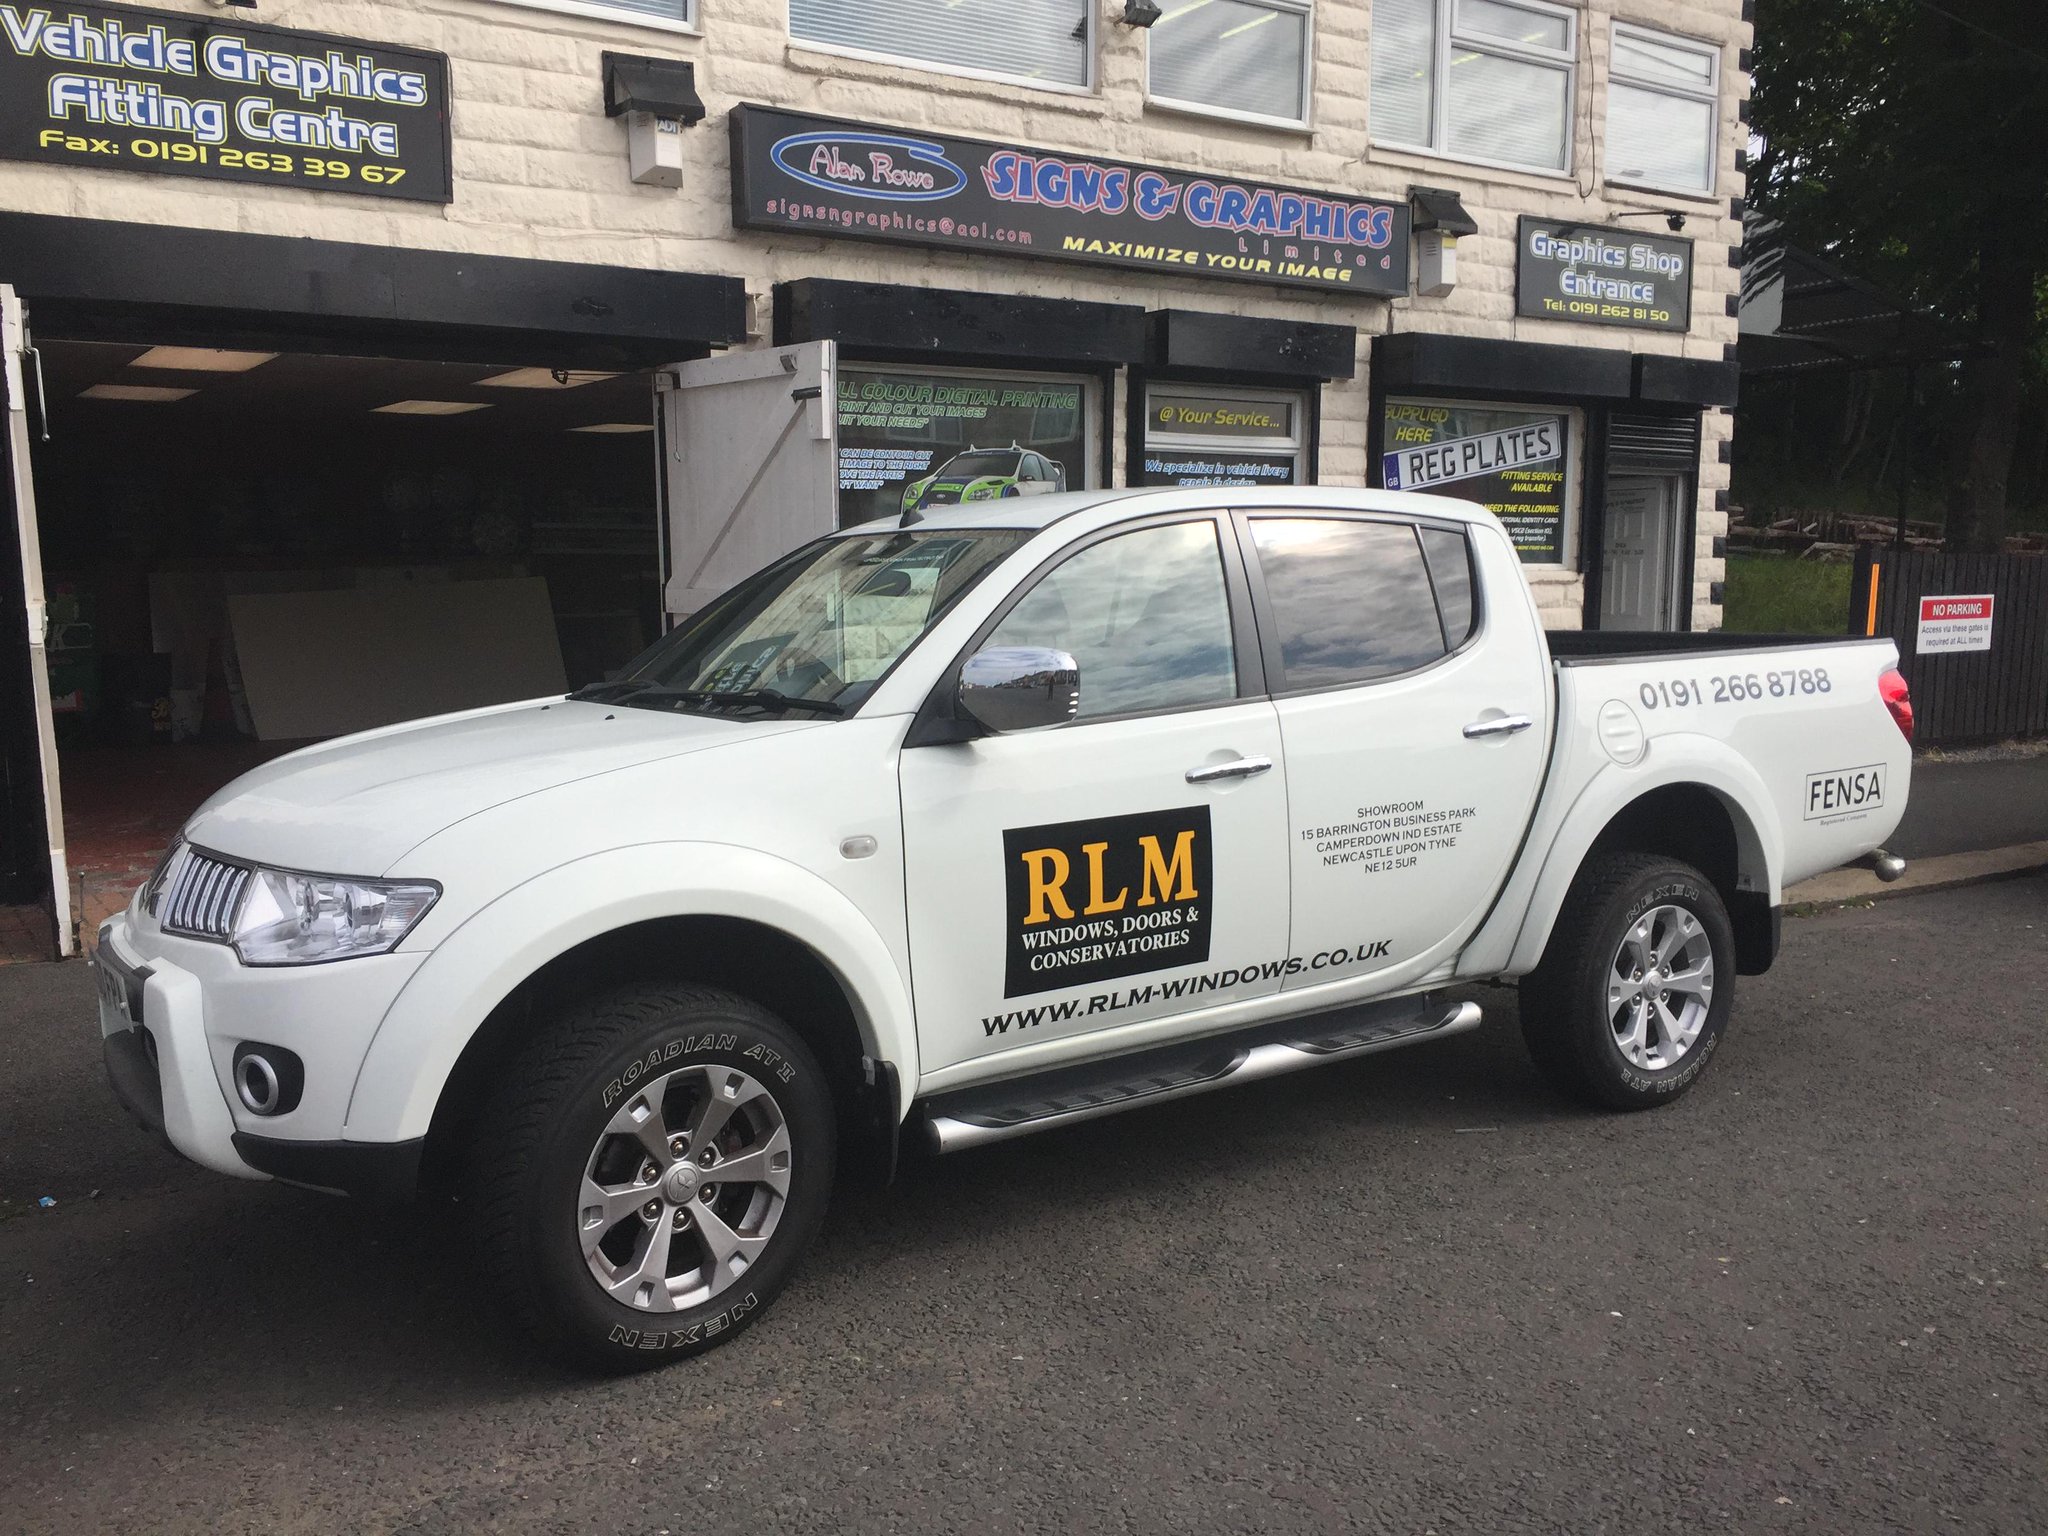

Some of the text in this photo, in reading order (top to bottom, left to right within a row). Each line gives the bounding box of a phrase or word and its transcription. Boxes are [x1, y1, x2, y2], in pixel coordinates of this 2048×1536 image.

[0, 5, 428, 106] Vehicle Graphics
[48, 74, 399, 157] Fitting Centre
[40, 130, 405, 185] Fax: 0191 263 39 67
[809, 144, 934, 189] Alan Rowe
[980, 150, 1394, 248] SIGNS & GRAPHICS
[766, 199, 1032, 244] signsngraphics@aol.com
[1063, 236, 1352, 281] MAXIMIZE YOUR IMAGE
[1530, 230, 1684, 280] Graphics Shop
[1559, 267, 1654, 304] Entrance
[1544, 298, 1669, 322] Tel: 0191 262 81 50
[861, 382, 932, 403] COLOUR
[936, 387, 998, 406] DIGITAL
[1001, 390, 1078, 409] PRINTING
[867, 402, 892, 415] AND
[893, 404, 917, 416] CUT
[917, 405, 945, 417] YOUR
[946, 407, 987, 419] IMAGES
[857, 415, 887, 427] YOUR
[1159, 406, 1174, 422] @
[1177, 407, 1212, 423] Your
[1395, 426, 1434, 442] HERE
[841, 448, 933, 460] CAN BE CONTOUR CUT
[844, 459, 874, 469] IMAGE
[874, 460, 885, 469] TO
[886, 460, 904, 470] THE
[903, 461, 930, 470] RIGHT
[1145, 459, 1290, 479] We specialize in vehicle livery
[1409, 426, 1552, 484] REG PLATES
[858, 469, 876, 479] THE
[876, 470, 906, 480] PARTS
[1387, 478, 1399, 488] GB
[1501, 471, 1564, 481] FITTING SERVICE
[1510, 483, 1553, 492] AVAILABLE
[1504, 504, 1519, 513] THE
[1932, 603, 1982, 616] NO PARKING
[1921, 625, 1942, 633] Access
[1952, 625, 1967, 633] these
[1968, 624, 1983, 633] gates
[1926, 638, 1949, 647] required
[1639, 668, 1832, 710] 0191 266 8788
[1810, 771, 1880, 811] FENSA
[1301, 807, 1476, 840] 15 BARRINGTON BUSINESS PARK
[1357, 800, 1424, 818] SHOWROOM
[1316, 822, 1462, 853] CAMPERDOWN IND ESTATE
[1323, 837, 1456, 866] NEWCASTLE UPON TYNE
[1021, 830, 1198, 925] RLM
[1396, 857, 1417, 869] 5UR
[1626, 884, 1700, 924] NEXEN
[1021, 906, 1199, 950] WINDOWS, DOORS &
[1030, 929, 1190, 971] CONSERVATORIES
[981, 940, 1392, 1037] WWW.RLM-WINDOWS.CO.UK
[603, 1034, 737, 1108] ROADIAN
[744, 1043, 781, 1066] AT
[609, 1292, 759, 1349] NEXEN
